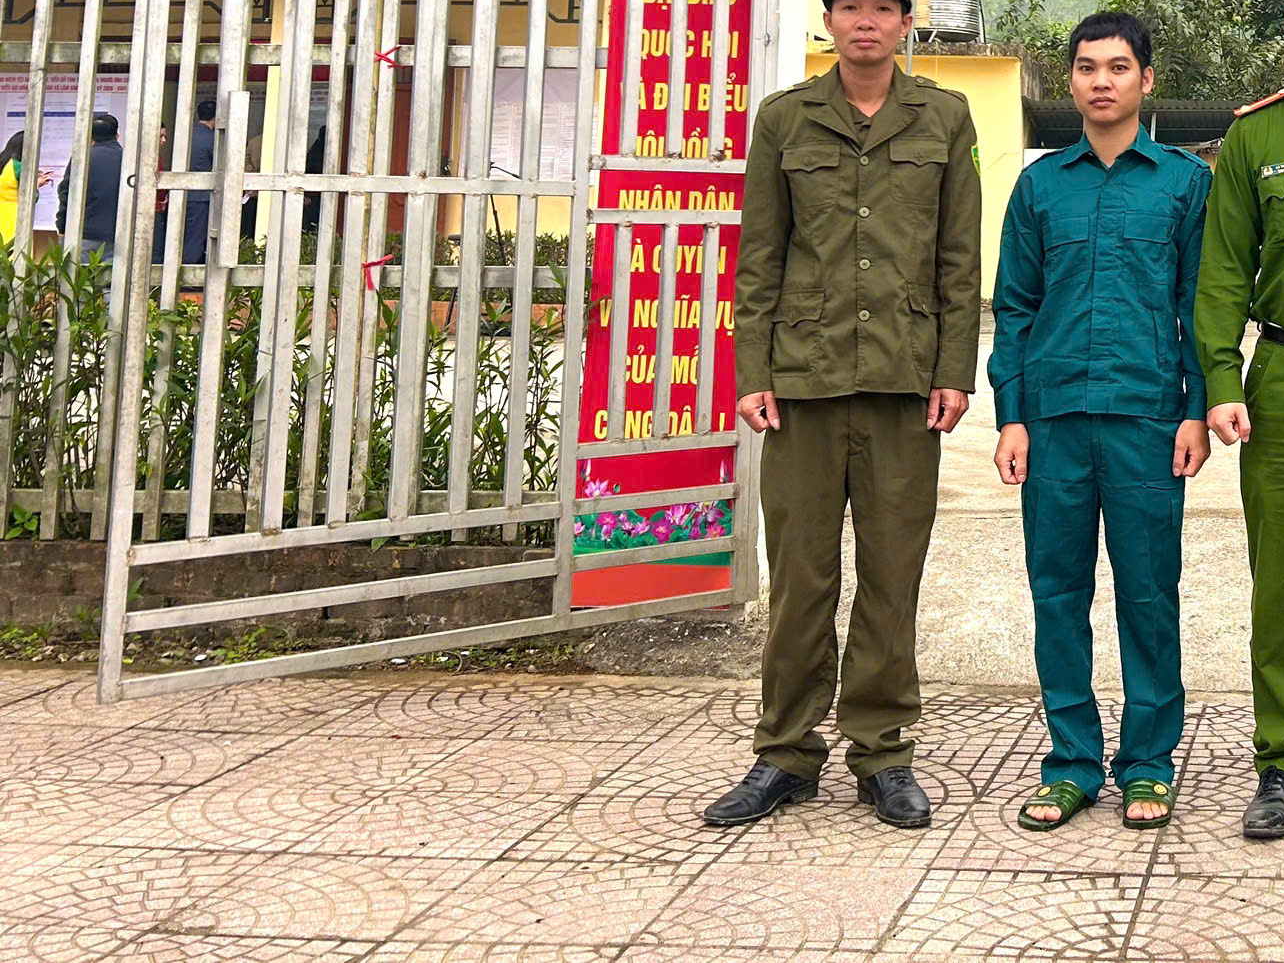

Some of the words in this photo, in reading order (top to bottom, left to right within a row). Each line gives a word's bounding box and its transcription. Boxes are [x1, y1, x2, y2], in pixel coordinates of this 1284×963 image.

[701, 30, 740, 58] HI
[653, 82, 692, 111] ĐI
[697, 72, 749, 112] BỂU
[619, 184, 681, 211] NHÂN
[688, 185, 735, 212] DÂN
[594, 409, 653, 440] CNG
[668, 405, 694, 436] DÂ
